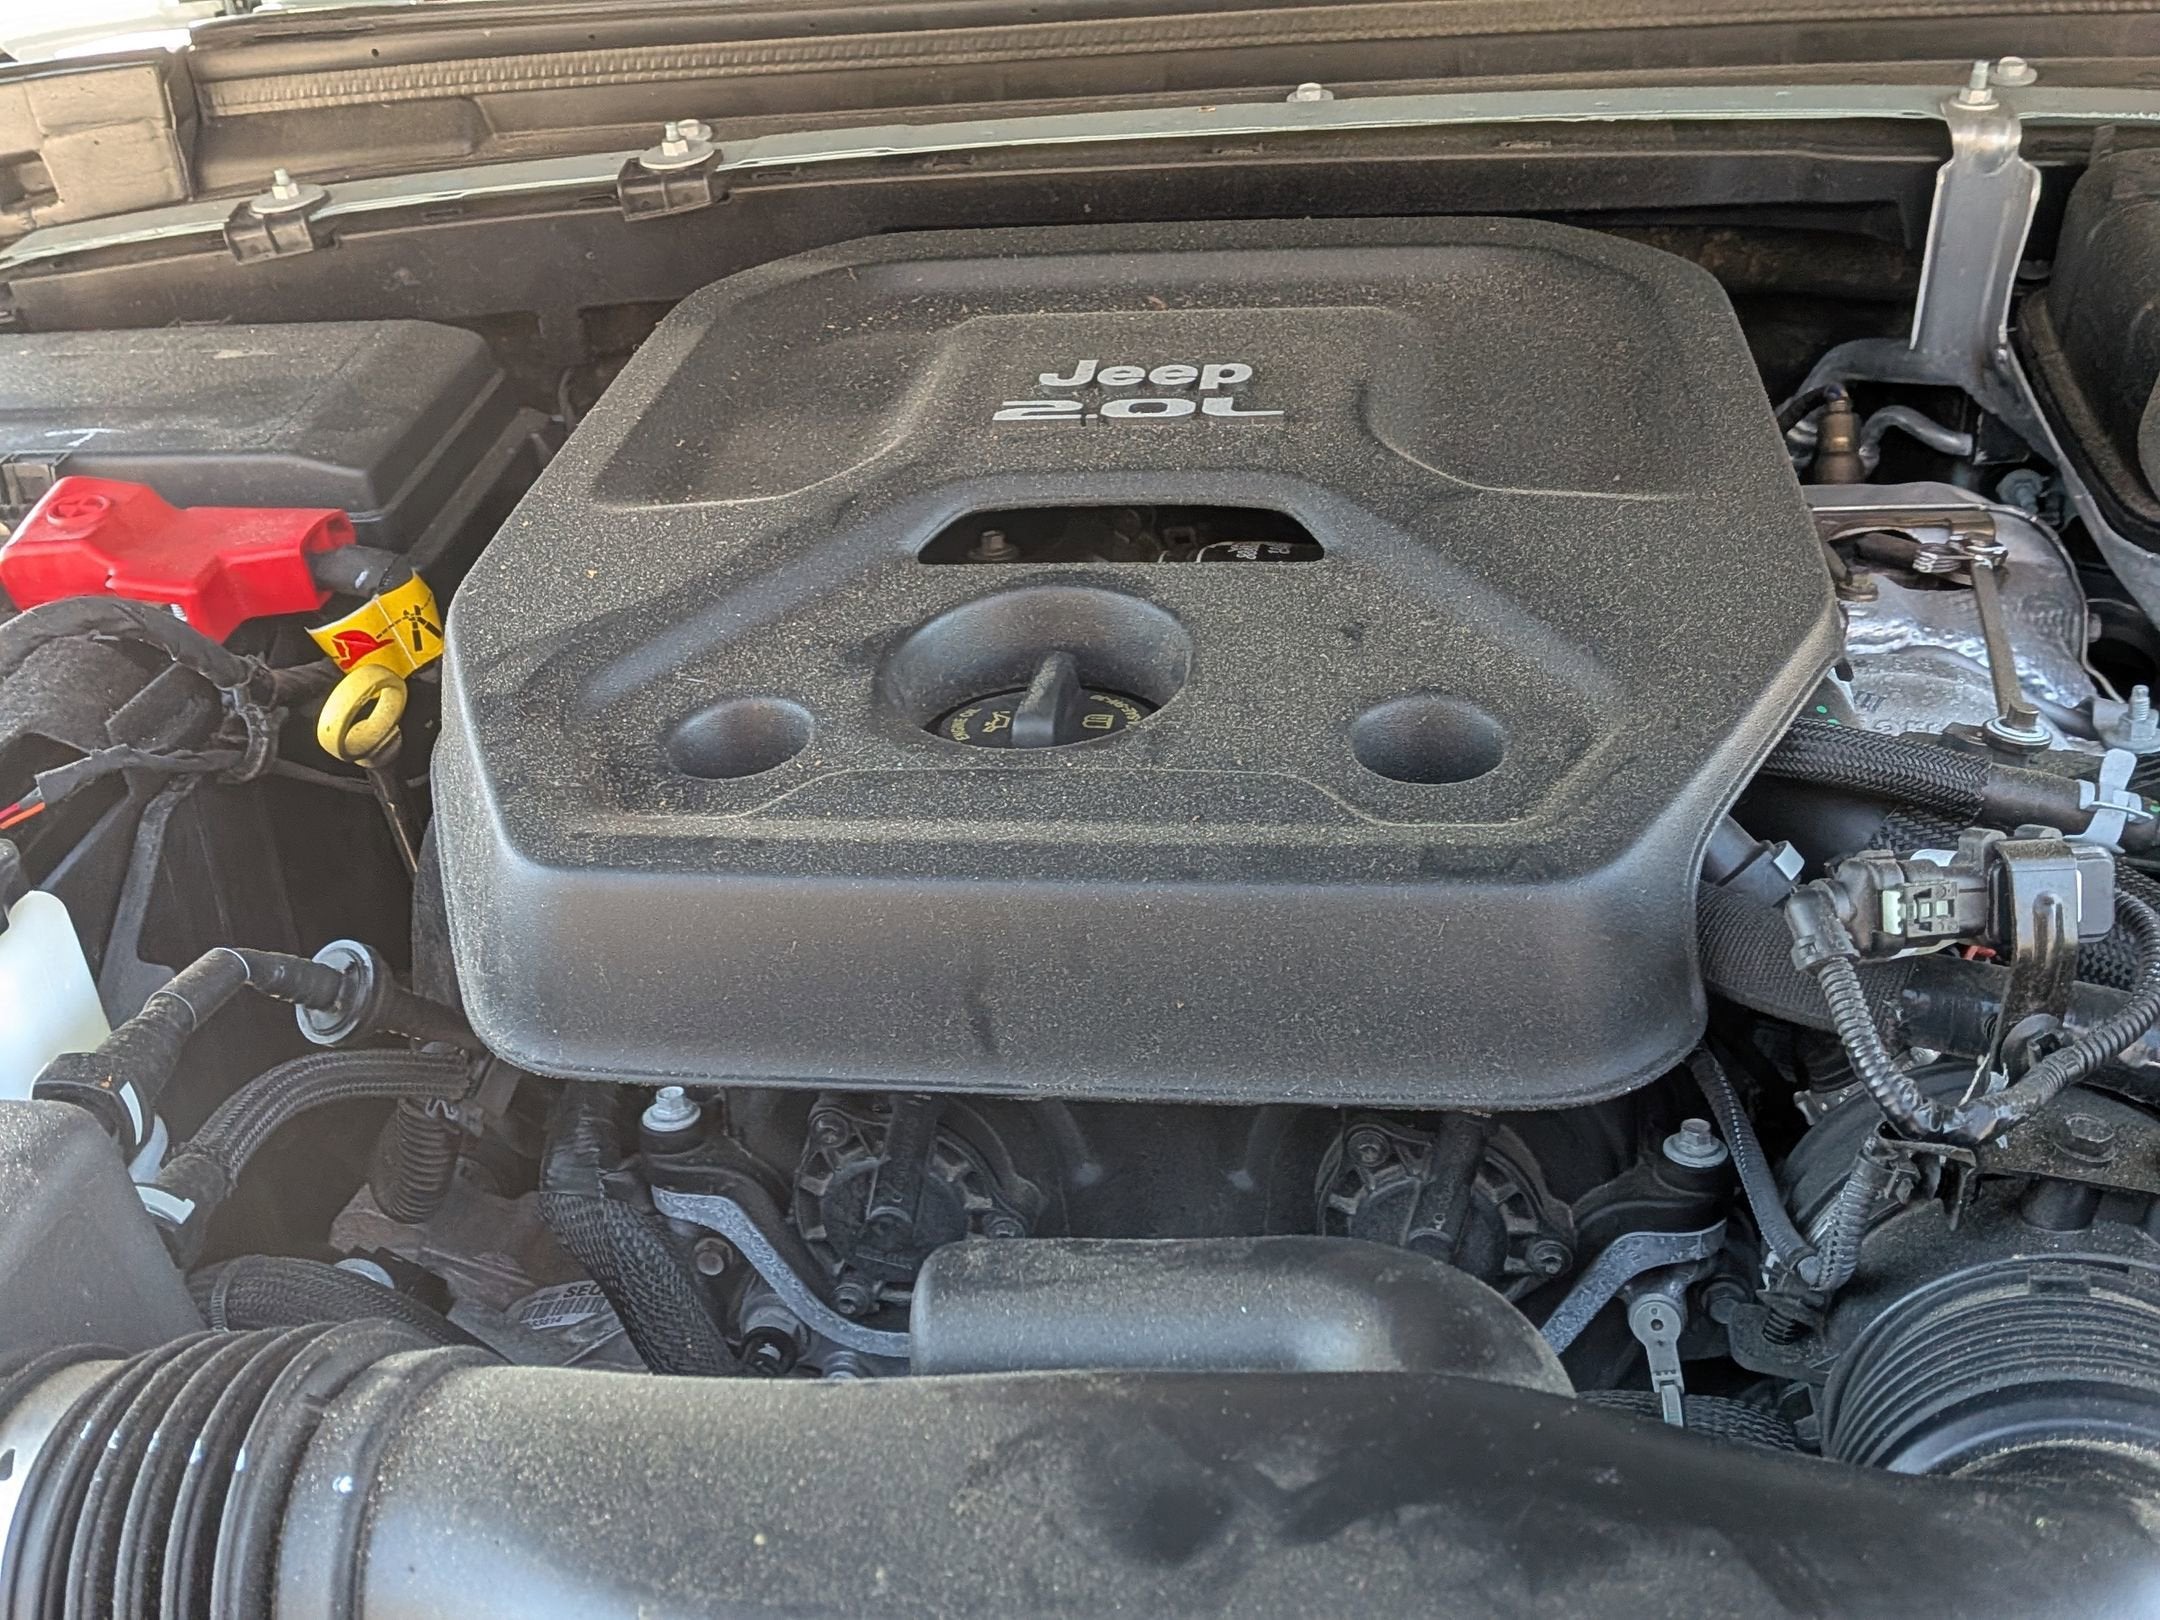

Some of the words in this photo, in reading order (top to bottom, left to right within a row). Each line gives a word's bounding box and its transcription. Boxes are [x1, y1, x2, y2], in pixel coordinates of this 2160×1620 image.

[1038, 359, 1253, 391] Jeep
[992, 397, 1285, 422] 2.0L
[959, 708, 983, 719] OIL
[950, 718, 970, 740] ENGINE
